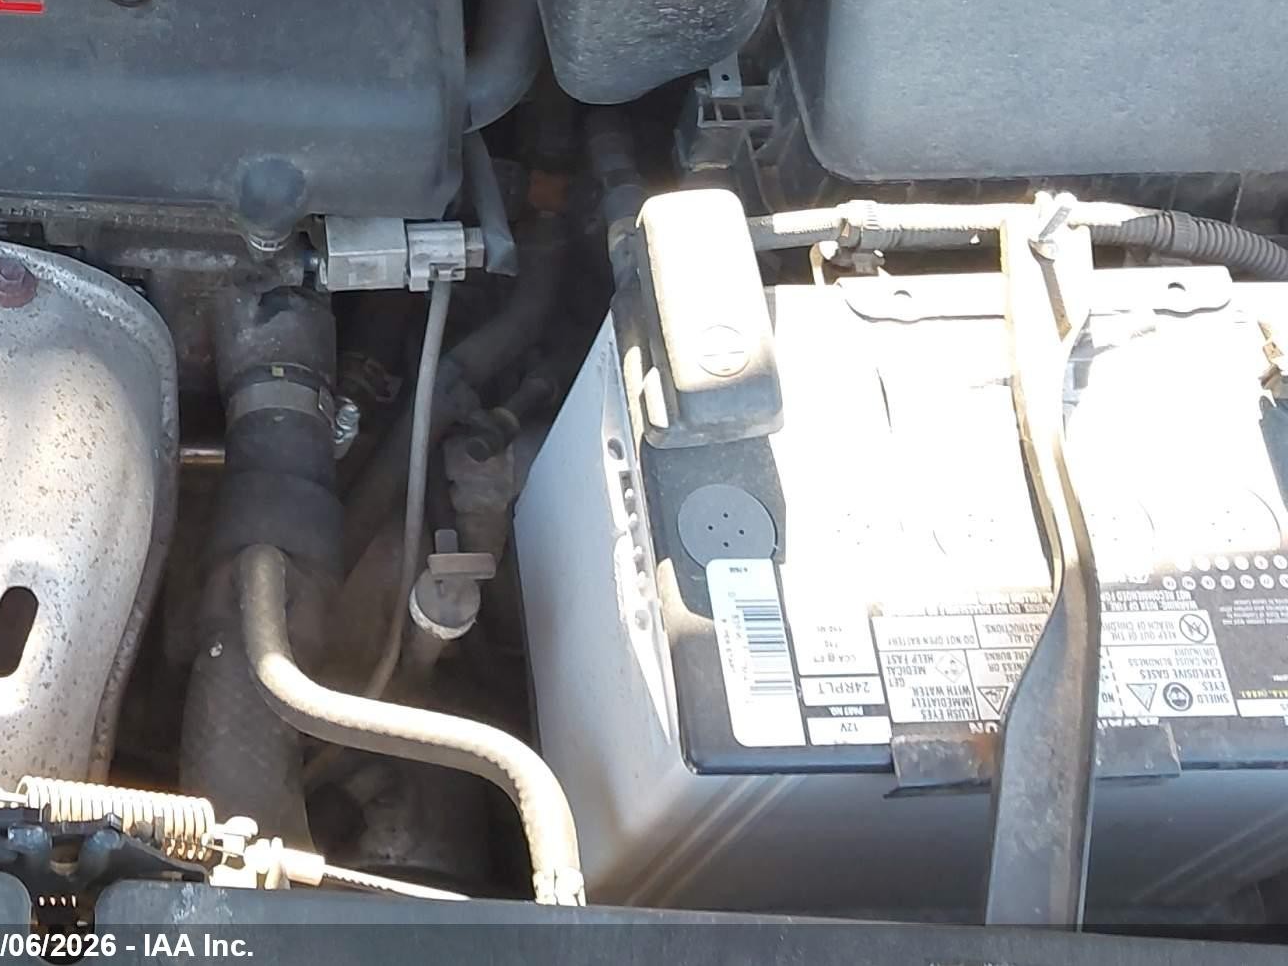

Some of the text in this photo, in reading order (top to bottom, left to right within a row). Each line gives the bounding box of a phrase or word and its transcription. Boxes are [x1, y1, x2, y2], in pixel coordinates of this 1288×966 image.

[1139, 668, 1223, 680] EXPLOSIVE GASES
[818, 681, 871, 694] 24RPLT
[947, 685, 972, 696] WITH
[911, 697, 973, 708] IMMEDIATELY
[920, 708, 977, 721] FLUSH EYES
[840, 722, 859, 732] 12V
